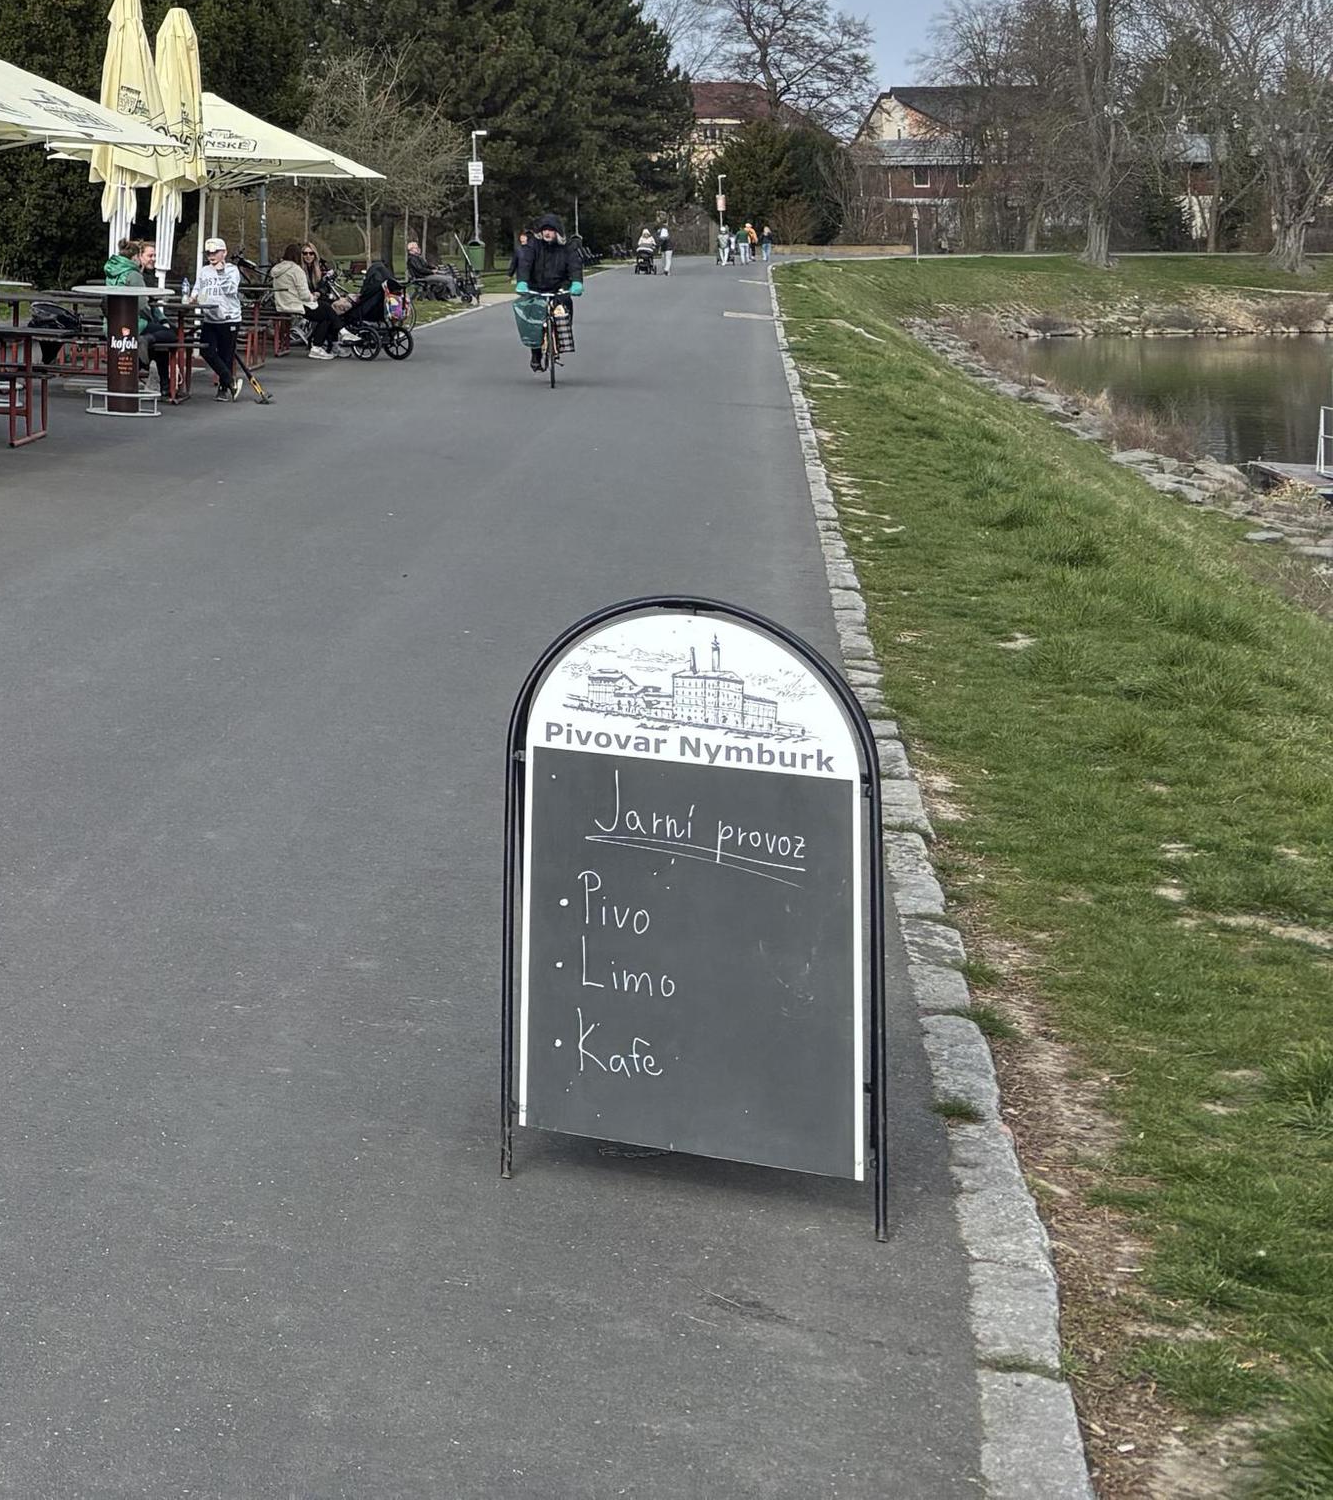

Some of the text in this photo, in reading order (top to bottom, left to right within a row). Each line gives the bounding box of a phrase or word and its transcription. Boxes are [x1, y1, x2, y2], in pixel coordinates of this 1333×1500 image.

[544, 721, 836, 773] Pivovar Nymburk
[594, 769, 806, 863] Jarní provoz
[578, 870, 650, 935] Pivo
[582, 934, 676, 997] Limo
[576, 1006, 663, 1079] Kafe
